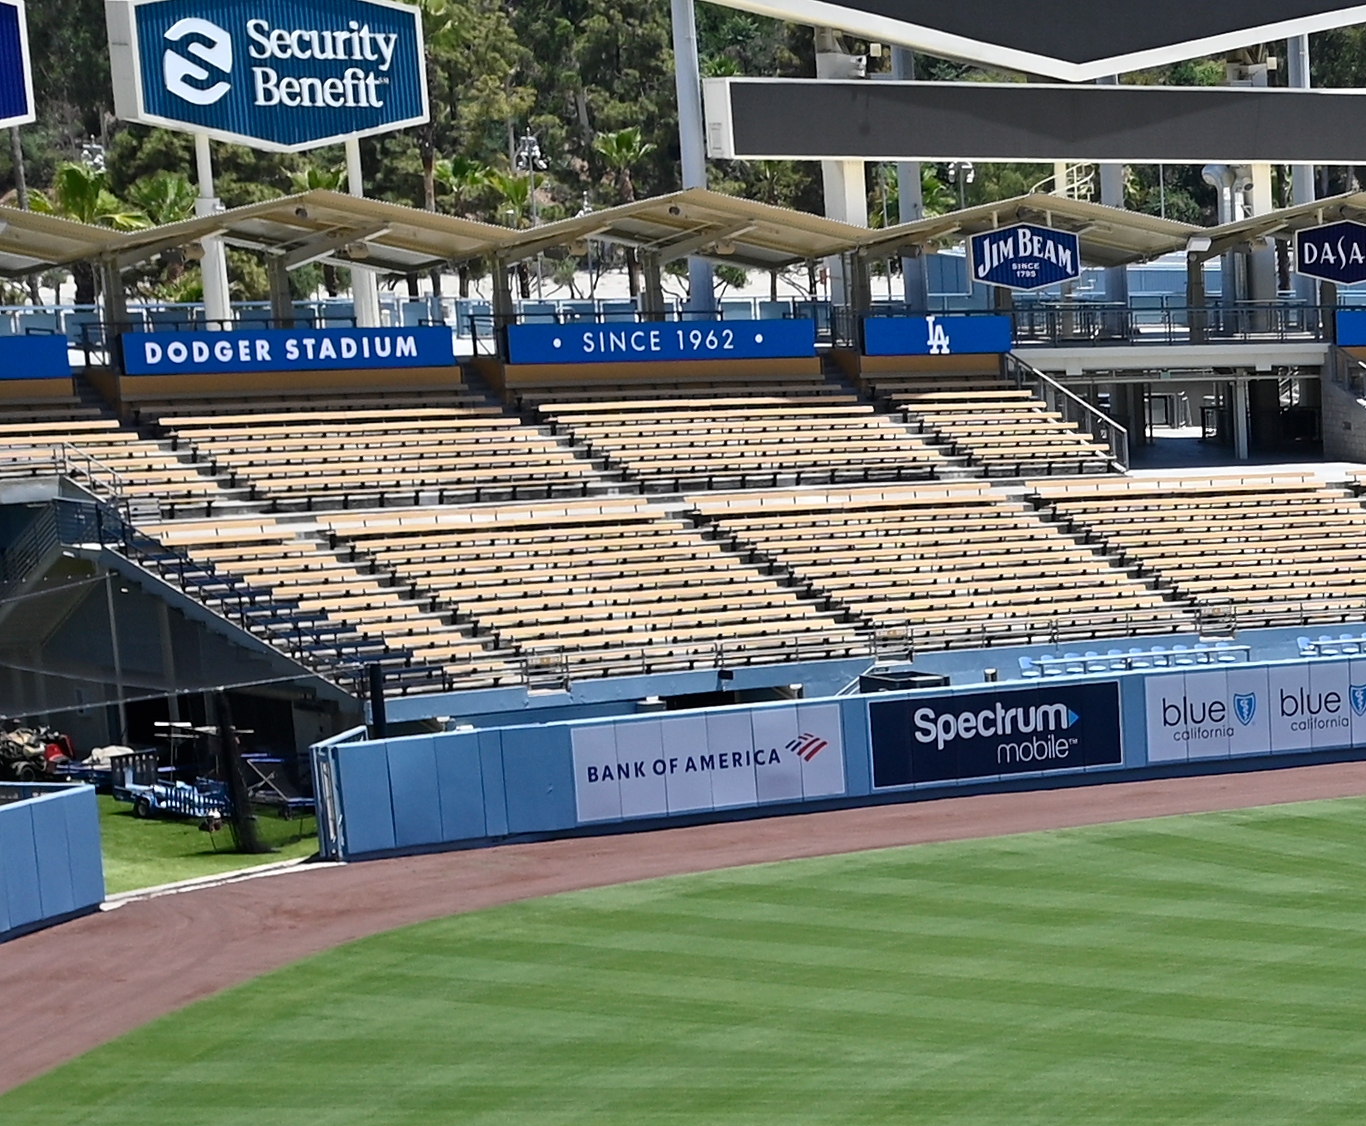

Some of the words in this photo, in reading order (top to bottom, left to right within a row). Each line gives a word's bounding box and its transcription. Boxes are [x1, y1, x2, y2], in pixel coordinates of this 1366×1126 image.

[247, 19, 397, 71] Security
[252, 67, 384, 108] Benefit
[978, 236, 1014, 278] JIM
[1017, 228, 1073, 275] BEAM
[1012, 262, 1040, 270] SINCE
[144, 339, 272, 364] DODGER
[285, 336, 417, 361] STADIUM
[583, 330, 661, 353] SINCE
[676, 329, 735, 350] 1962
[1162, 696, 1226, 727] blue
[1279, 686, 1341, 717] blue
[914, 702, 1068, 750] Spectrum
[1173, 725, 1234, 742] california
[1290, 715, 1349, 732] california
[997, 734, 1069, 764] mobile
[587, 761, 646, 783] BANK
[652, 757, 678, 775] OF
[685, 749, 781, 773] AMERICA
